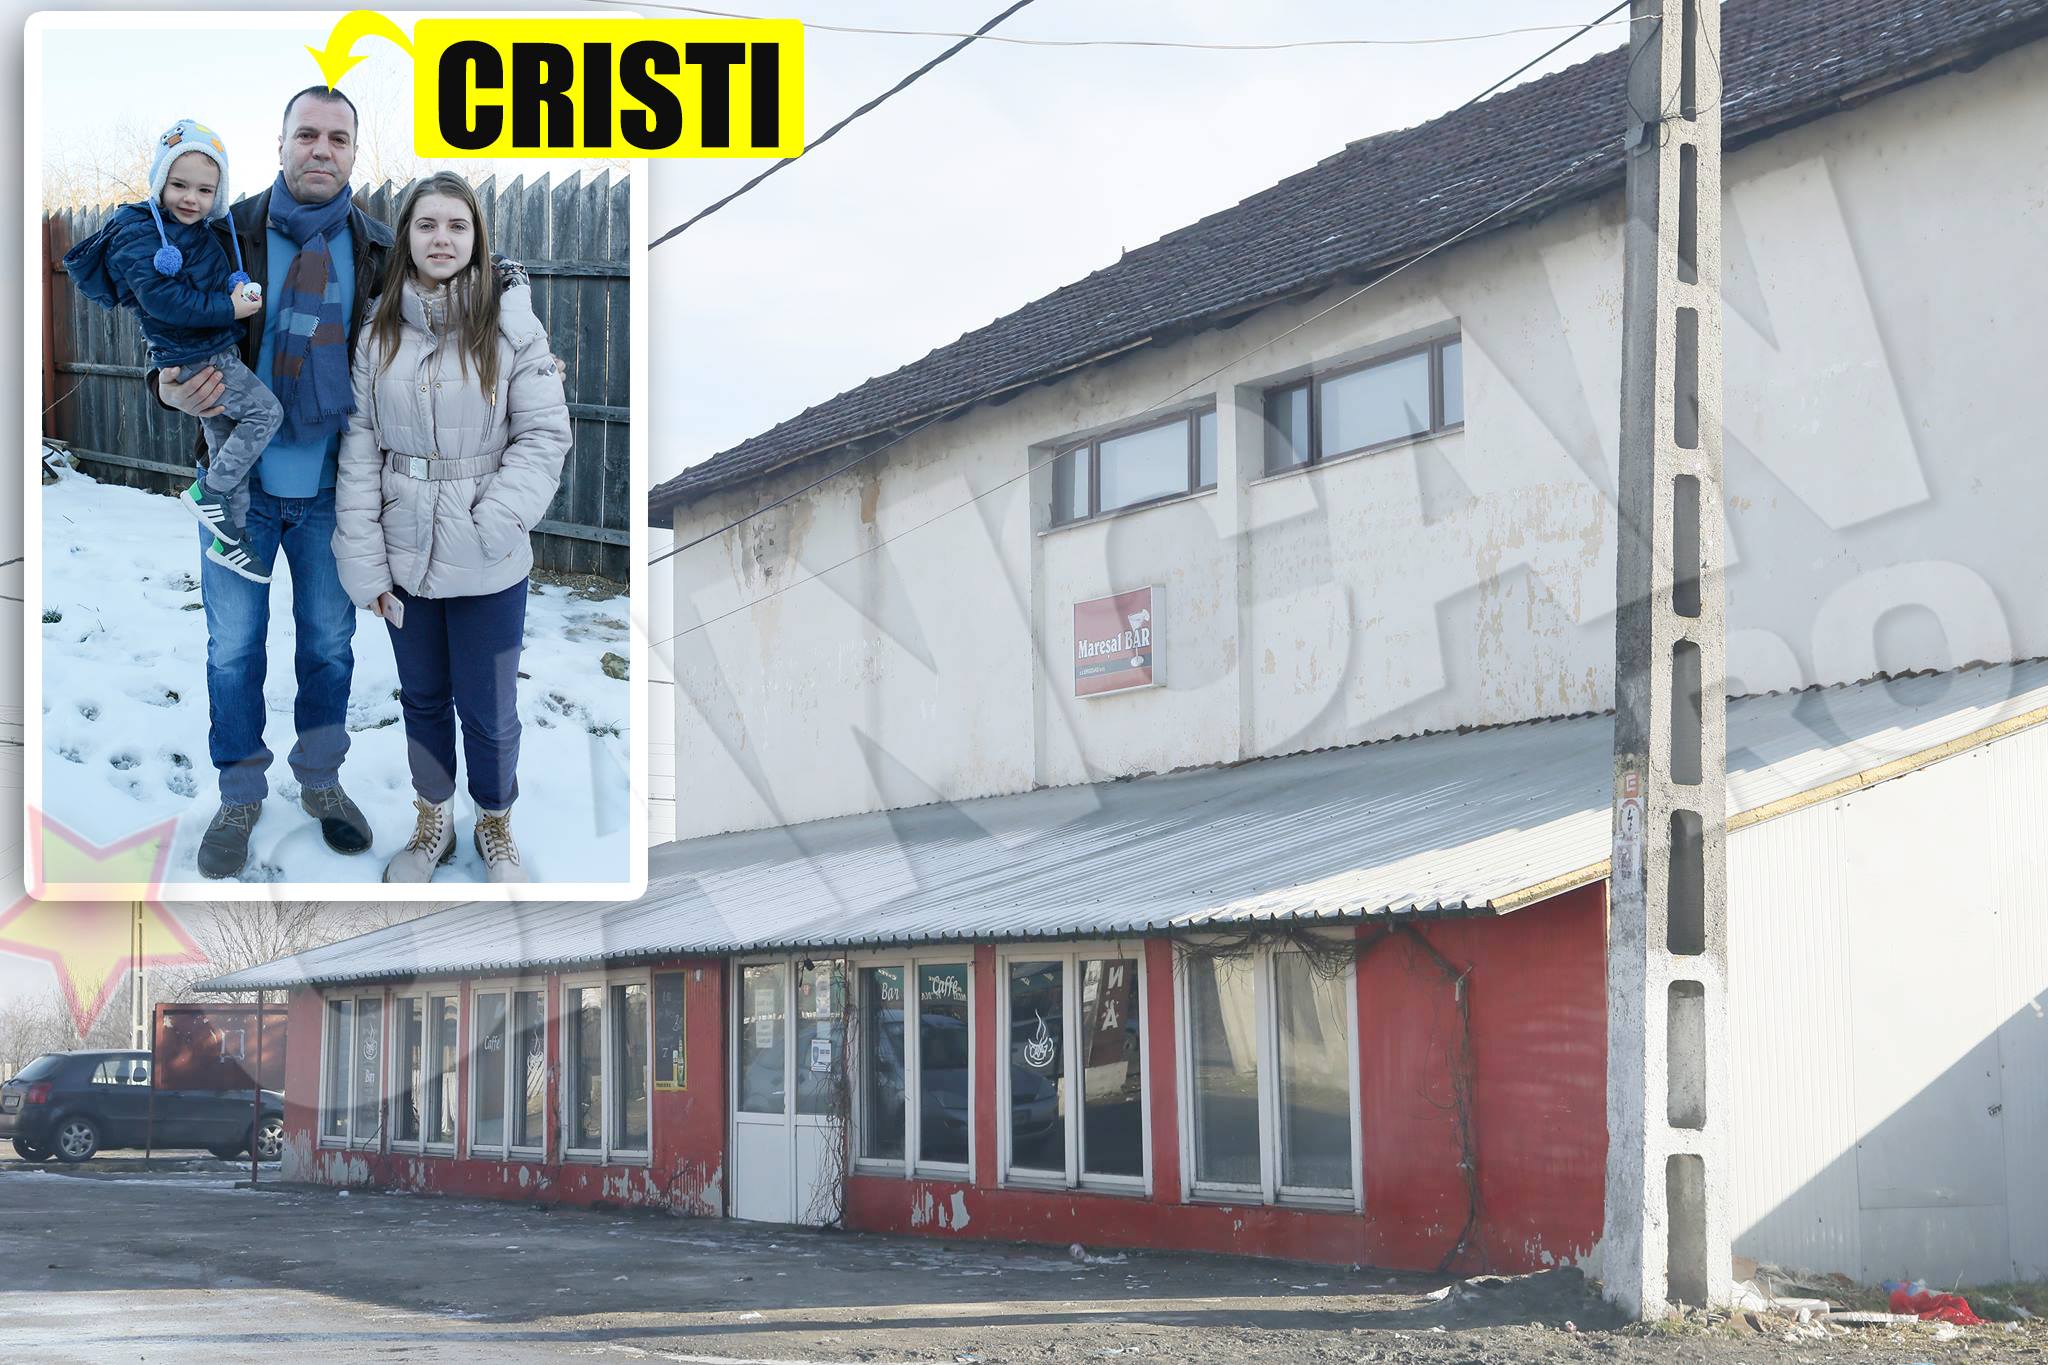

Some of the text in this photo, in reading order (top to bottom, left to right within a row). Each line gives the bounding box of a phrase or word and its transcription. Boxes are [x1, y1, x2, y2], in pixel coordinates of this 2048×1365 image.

[1124, 627, 1150, 650] BAR
[881, 982, 899, 1001] Bar
[932, 975, 958, 997] Caffe
